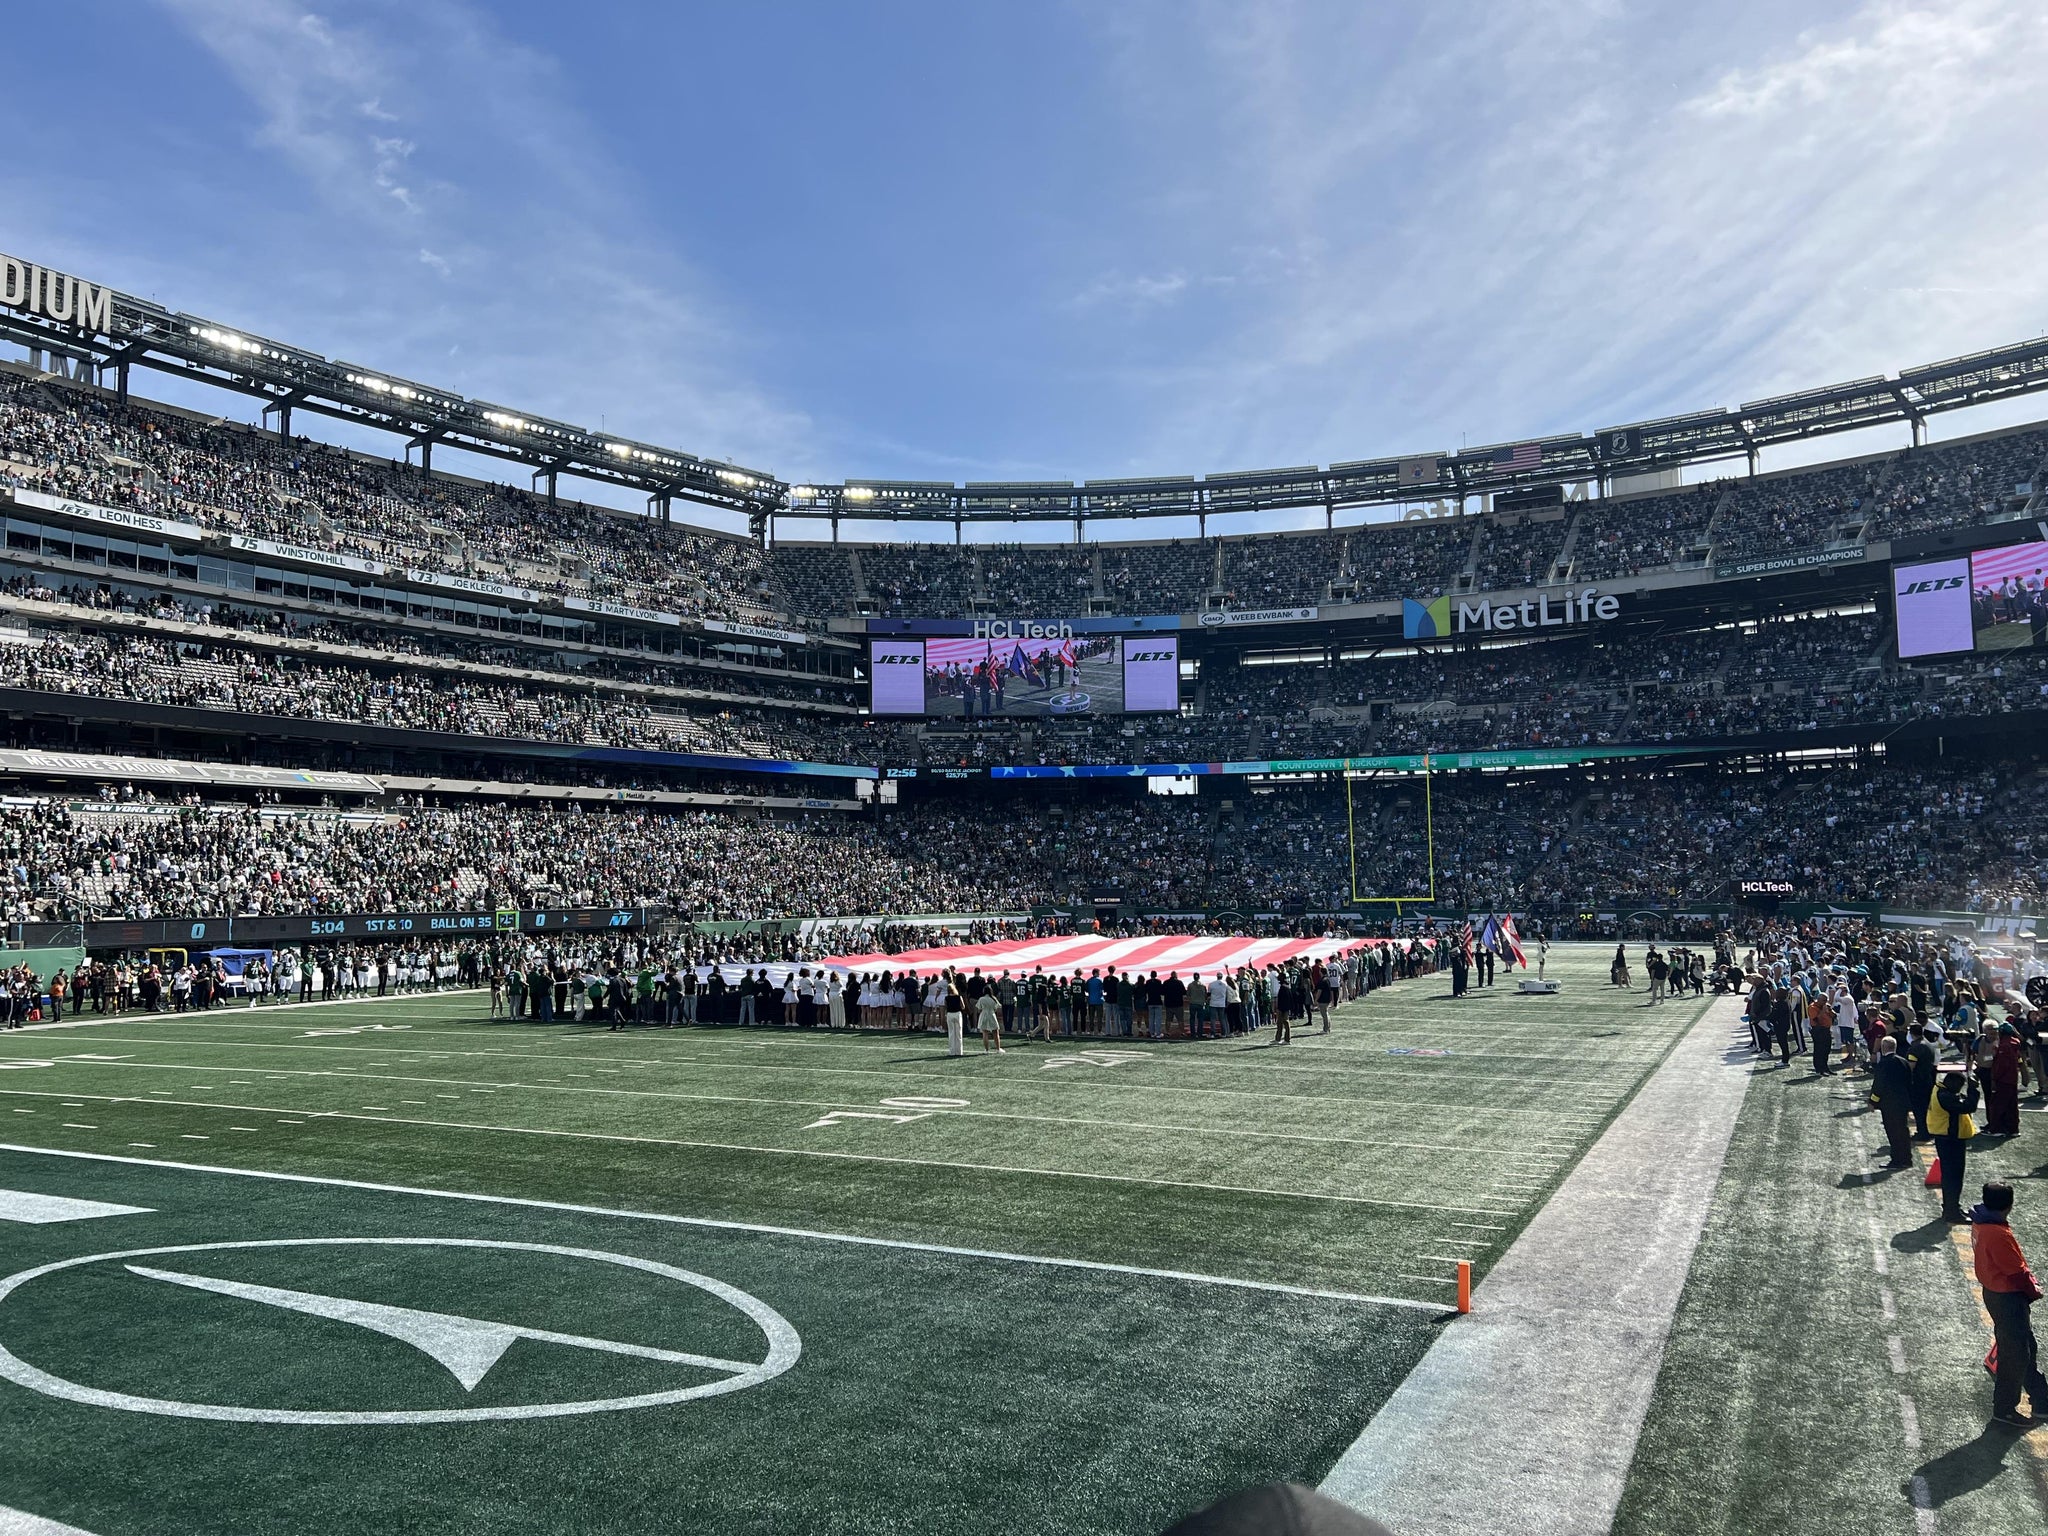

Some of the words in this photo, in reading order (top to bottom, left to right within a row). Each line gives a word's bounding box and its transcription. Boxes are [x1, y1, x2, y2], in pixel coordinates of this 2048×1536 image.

[56, 503, 91, 517] JETS
[99, 508, 131, 524] LEON
[133, 516, 163, 530] HESS
[240, 536, 259, 550] 75
[275, 544, 325, 562] WINSTON
[325, 554, 346, 567] HILL
[1736, 563, 1766, 574] SUPER
[1767, 559, 1798, 570] BOWL
[1806, 549, 1864, 564] CHAMPIONS
[416, 571, 433, 583] 73
[452, 578, 469, 589] JOE
[469, 580, 503, 595] KLECKO
[1897, 575, 1967, 597] JETS
[588, 601, 602, 611] 93
[605, 604, 635, 617] MARTY
[635, 609, 659, 621] LYONS
[1231, 613, 1256, 621] WEEB
[1256, 611, 1294, 620] EWBANK
[1458, 588, 1620, 633] MetLife
[724, 622, 737, 633] 74
[739, 626, 755, 635] NICK
[755, 628, 789, 640] MANGOLD
[973, 620, 1073, 639] HCLTech
[873, 655, 922, 665] JETS
[1126, 651, 1176, 662] JETS
[21, 754, 104, 769] METLIFE
[101, 760, 181, 775] STADIUM
[1277, 761, 1336, 770] COUNTDOWN
[1475, 755, 1517, 765] MetLife
[886, 768, 917, 777] 12:56
[314, 776, 362, 785] MetLife
[82, 803, 111, 812] NEW
[113, 804, 149, 813] YORK
[1741, 881, 1793, 892] HCLTech
[365, 919, 386, 931] 1ST
[387, 919, 397, 931] &
[400, 918, 413, 930] 10
[431, 918, 458, 929] BALL
[459, 917, 475, 928] ON
[477, 916, 492, 928] 35
[536, 914, 546, 927] 0
[609, 913, 633, 926] NY
[190, 923, 206, 939] 0
[310, 920, 345, 934] 5:04
[1017, 985, 1026, 996] 16
[1072, 985, 1082, 994] 23
[1044, 1050, 1154, 1067] 20
[818, 1096, 971, 1125] 10
